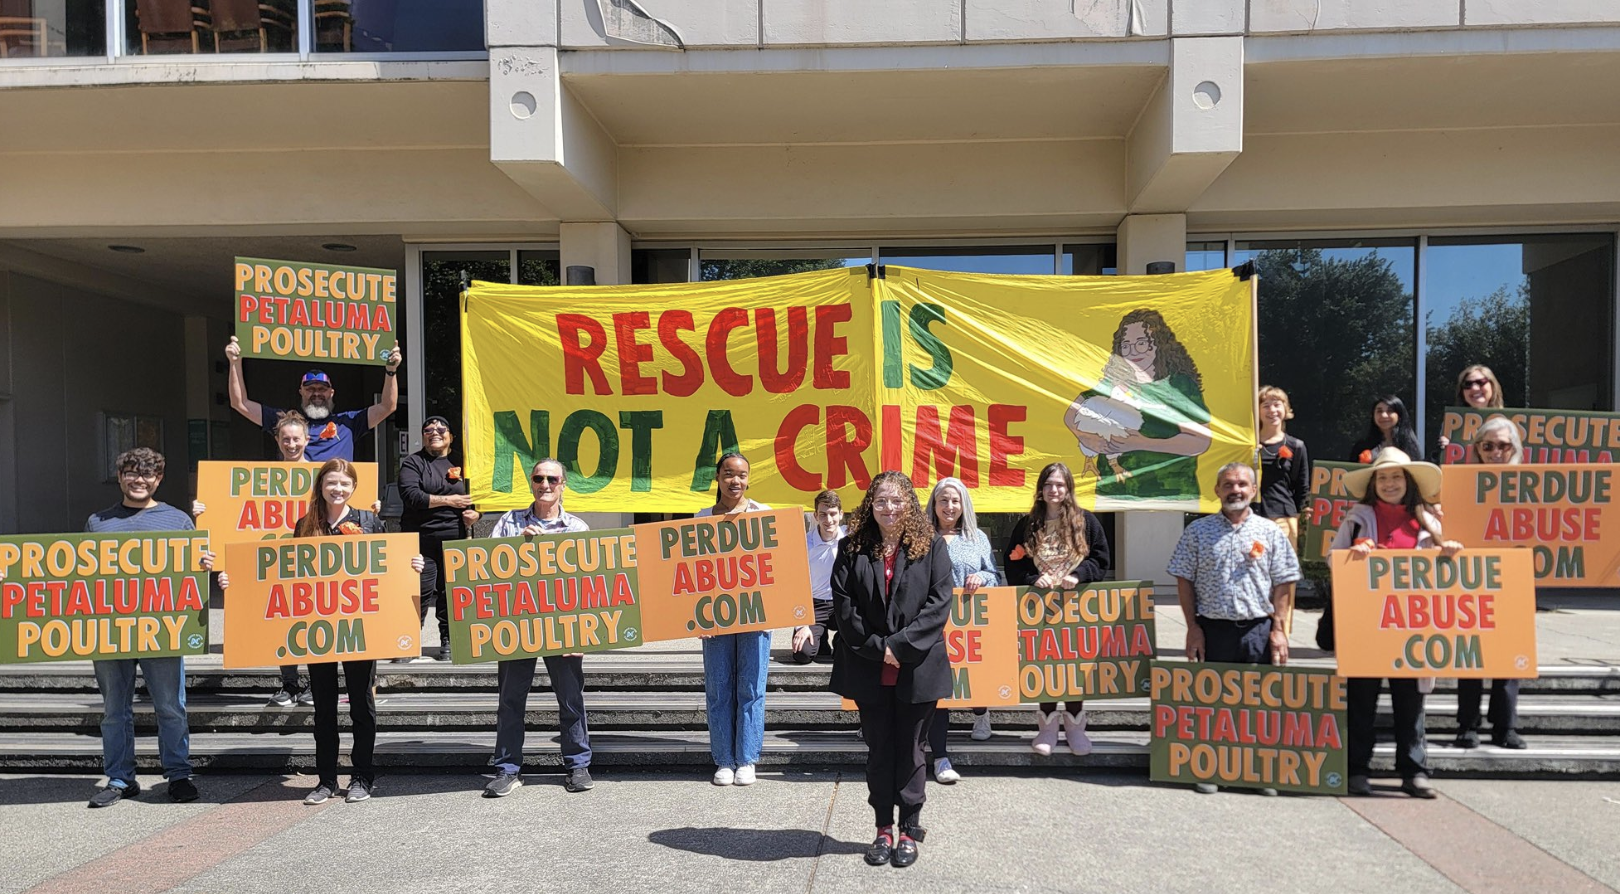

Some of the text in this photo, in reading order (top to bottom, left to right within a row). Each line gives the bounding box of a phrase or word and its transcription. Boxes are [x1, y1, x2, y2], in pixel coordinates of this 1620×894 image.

[235, 263, 396, 303] PROSECUTE
[240, 294, 392, 332] PETALUMA
[252, 326, 380, 360] POULTRY
[555, 300, 953, 397] RESCUE IS
[491, 404, 1027, 494] NOT A CRIME
[1444, 412, 1620, 449] PRSECUTE
[230, 467, 324, 497] PERD
[1476, 470, 1612, 504] PERDUE
[236, 500, 307, 531] ABU
[1483, 508, 1602, 541] ABUSE
[659, 515, 778, 560] PERDUE
[0, 538, 209, 578] PROSECUTE
[257, 540, 388, 581] PERDUE
[444, 535, 637, 583] PROSECUTE
[672, 553, 774, 596] ABUSE
[1368, 556, 1502, 591] PERDUE
[2, 576, 203, 618] PETALUMA
[265, 578, 379, 620] ABUSE
[452, 573, 635, 621] PETALUMA
[686, 591, 766, 631] .COM
[1018, 588, 1154, 625] OSECUTE
[1379, 594, 1495, 630] ABUSE
[18, 615, 188, 657] POULTRY
[276, 618, 367, 658] .COM
[470, 610, 622, 658] POULTRY
[1017, 624, 1153, 662] TALUMA
[1393, 634, 1484, 670] .COM
[1019, 661, 1140, 698] OULTRY
[1151, 667, 1347, 710] PROSECUTE
[1156, 704, 1342, 749] PETALUMA
[1169, 742, 1327, 786] POULTRY
